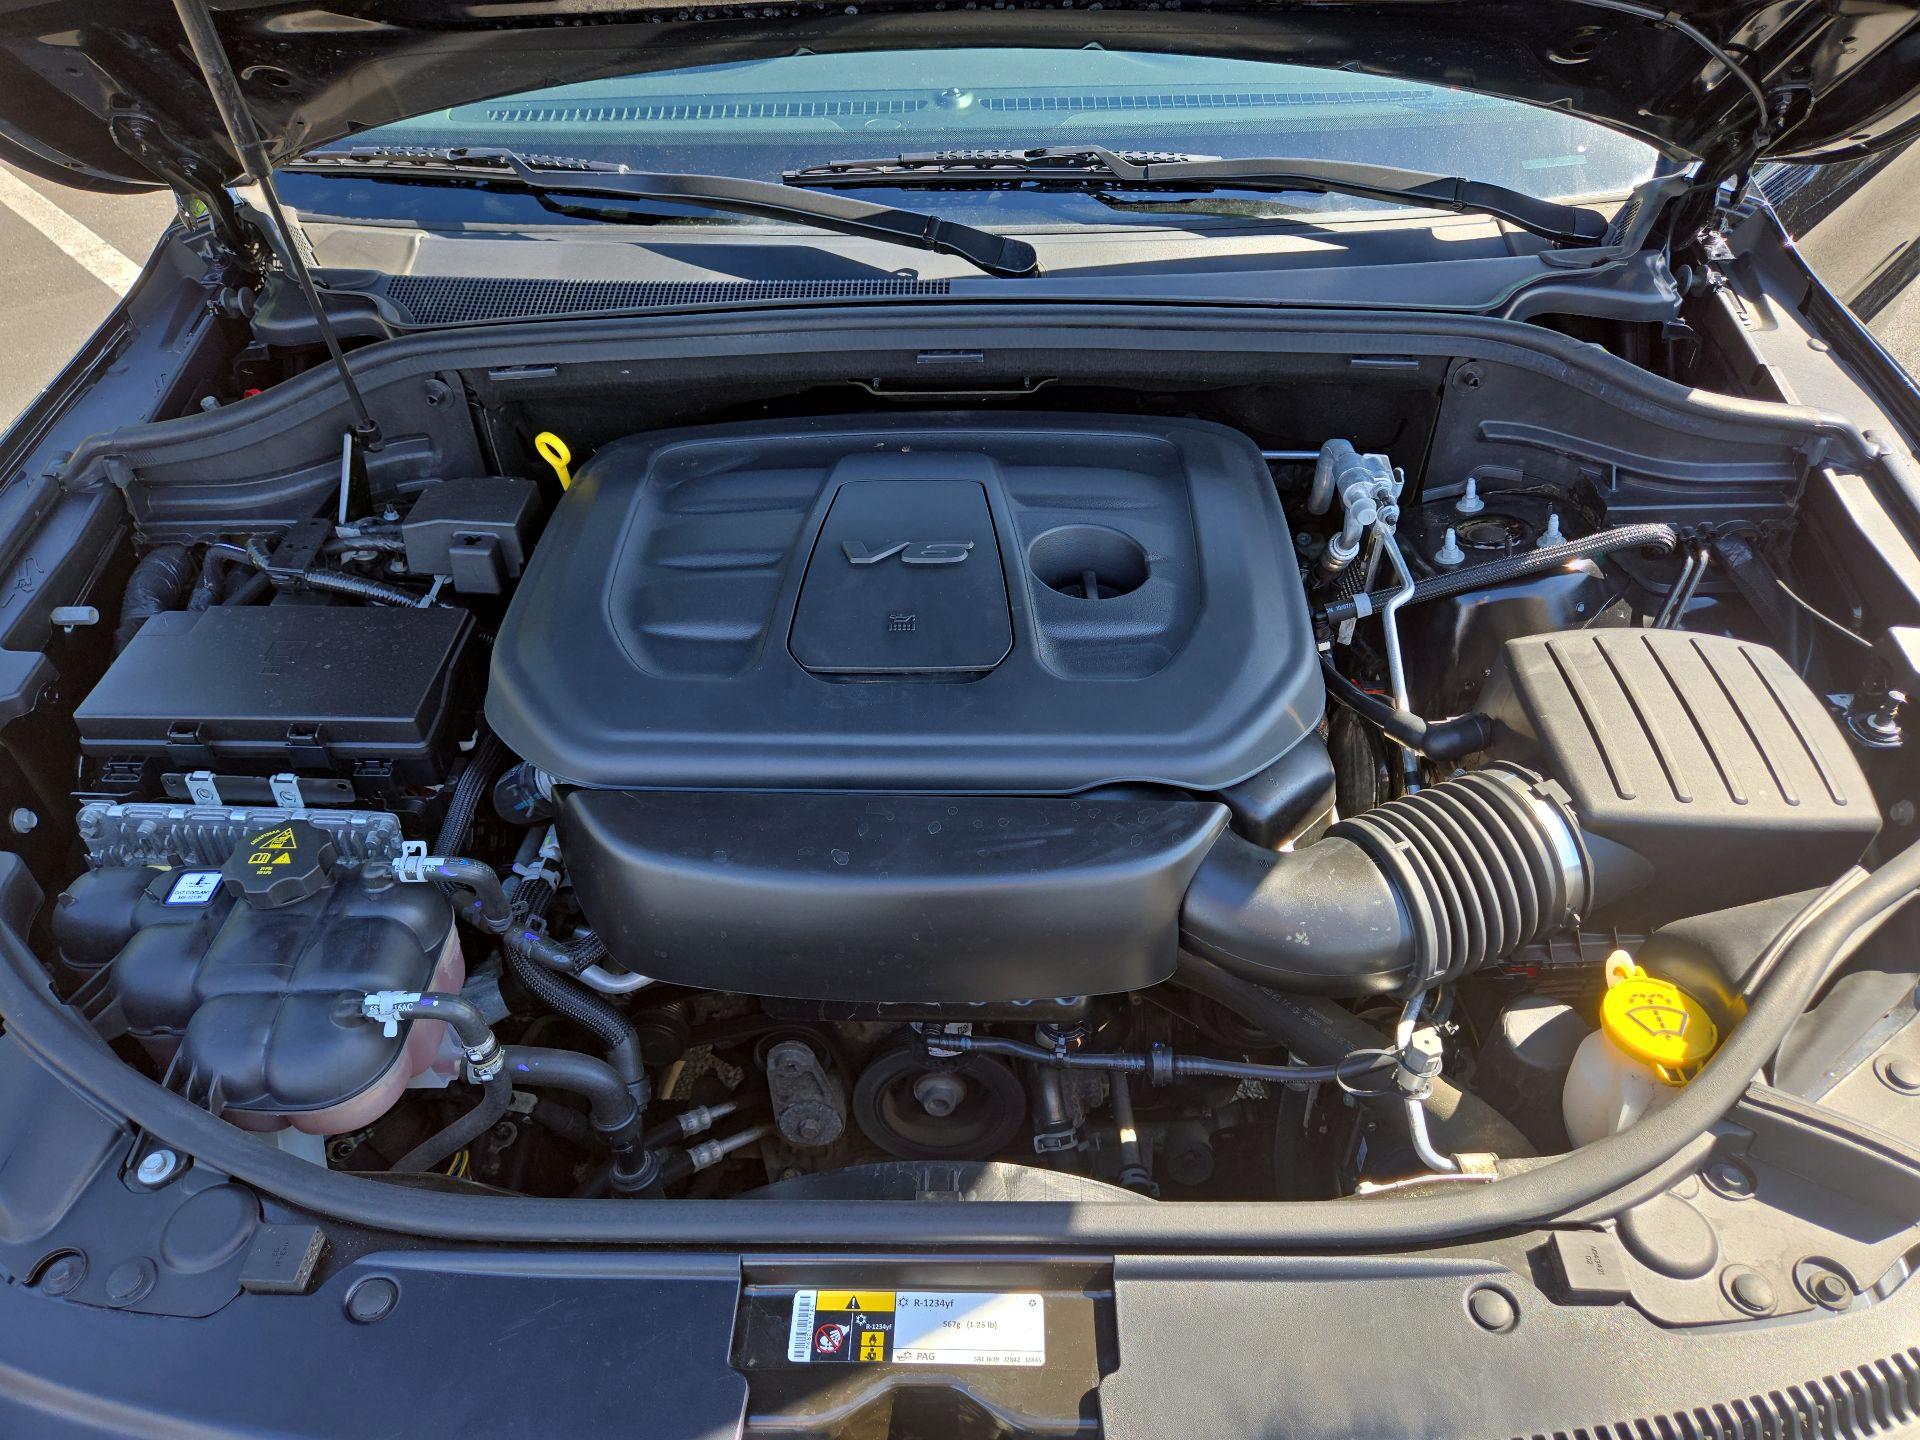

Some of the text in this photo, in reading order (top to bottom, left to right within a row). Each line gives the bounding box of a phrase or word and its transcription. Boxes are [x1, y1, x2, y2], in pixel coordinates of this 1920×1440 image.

[841, 540, 975, 564] V6
[914, 1299, 954, 1309] R-1234yf
[866, 1323, 892, 1331] R-1234yf
[943, 1320, 961, 1329] 567g
[966, 1321, 986, 1330] (1.25
[916, 1352, 936, 1361] PAG
